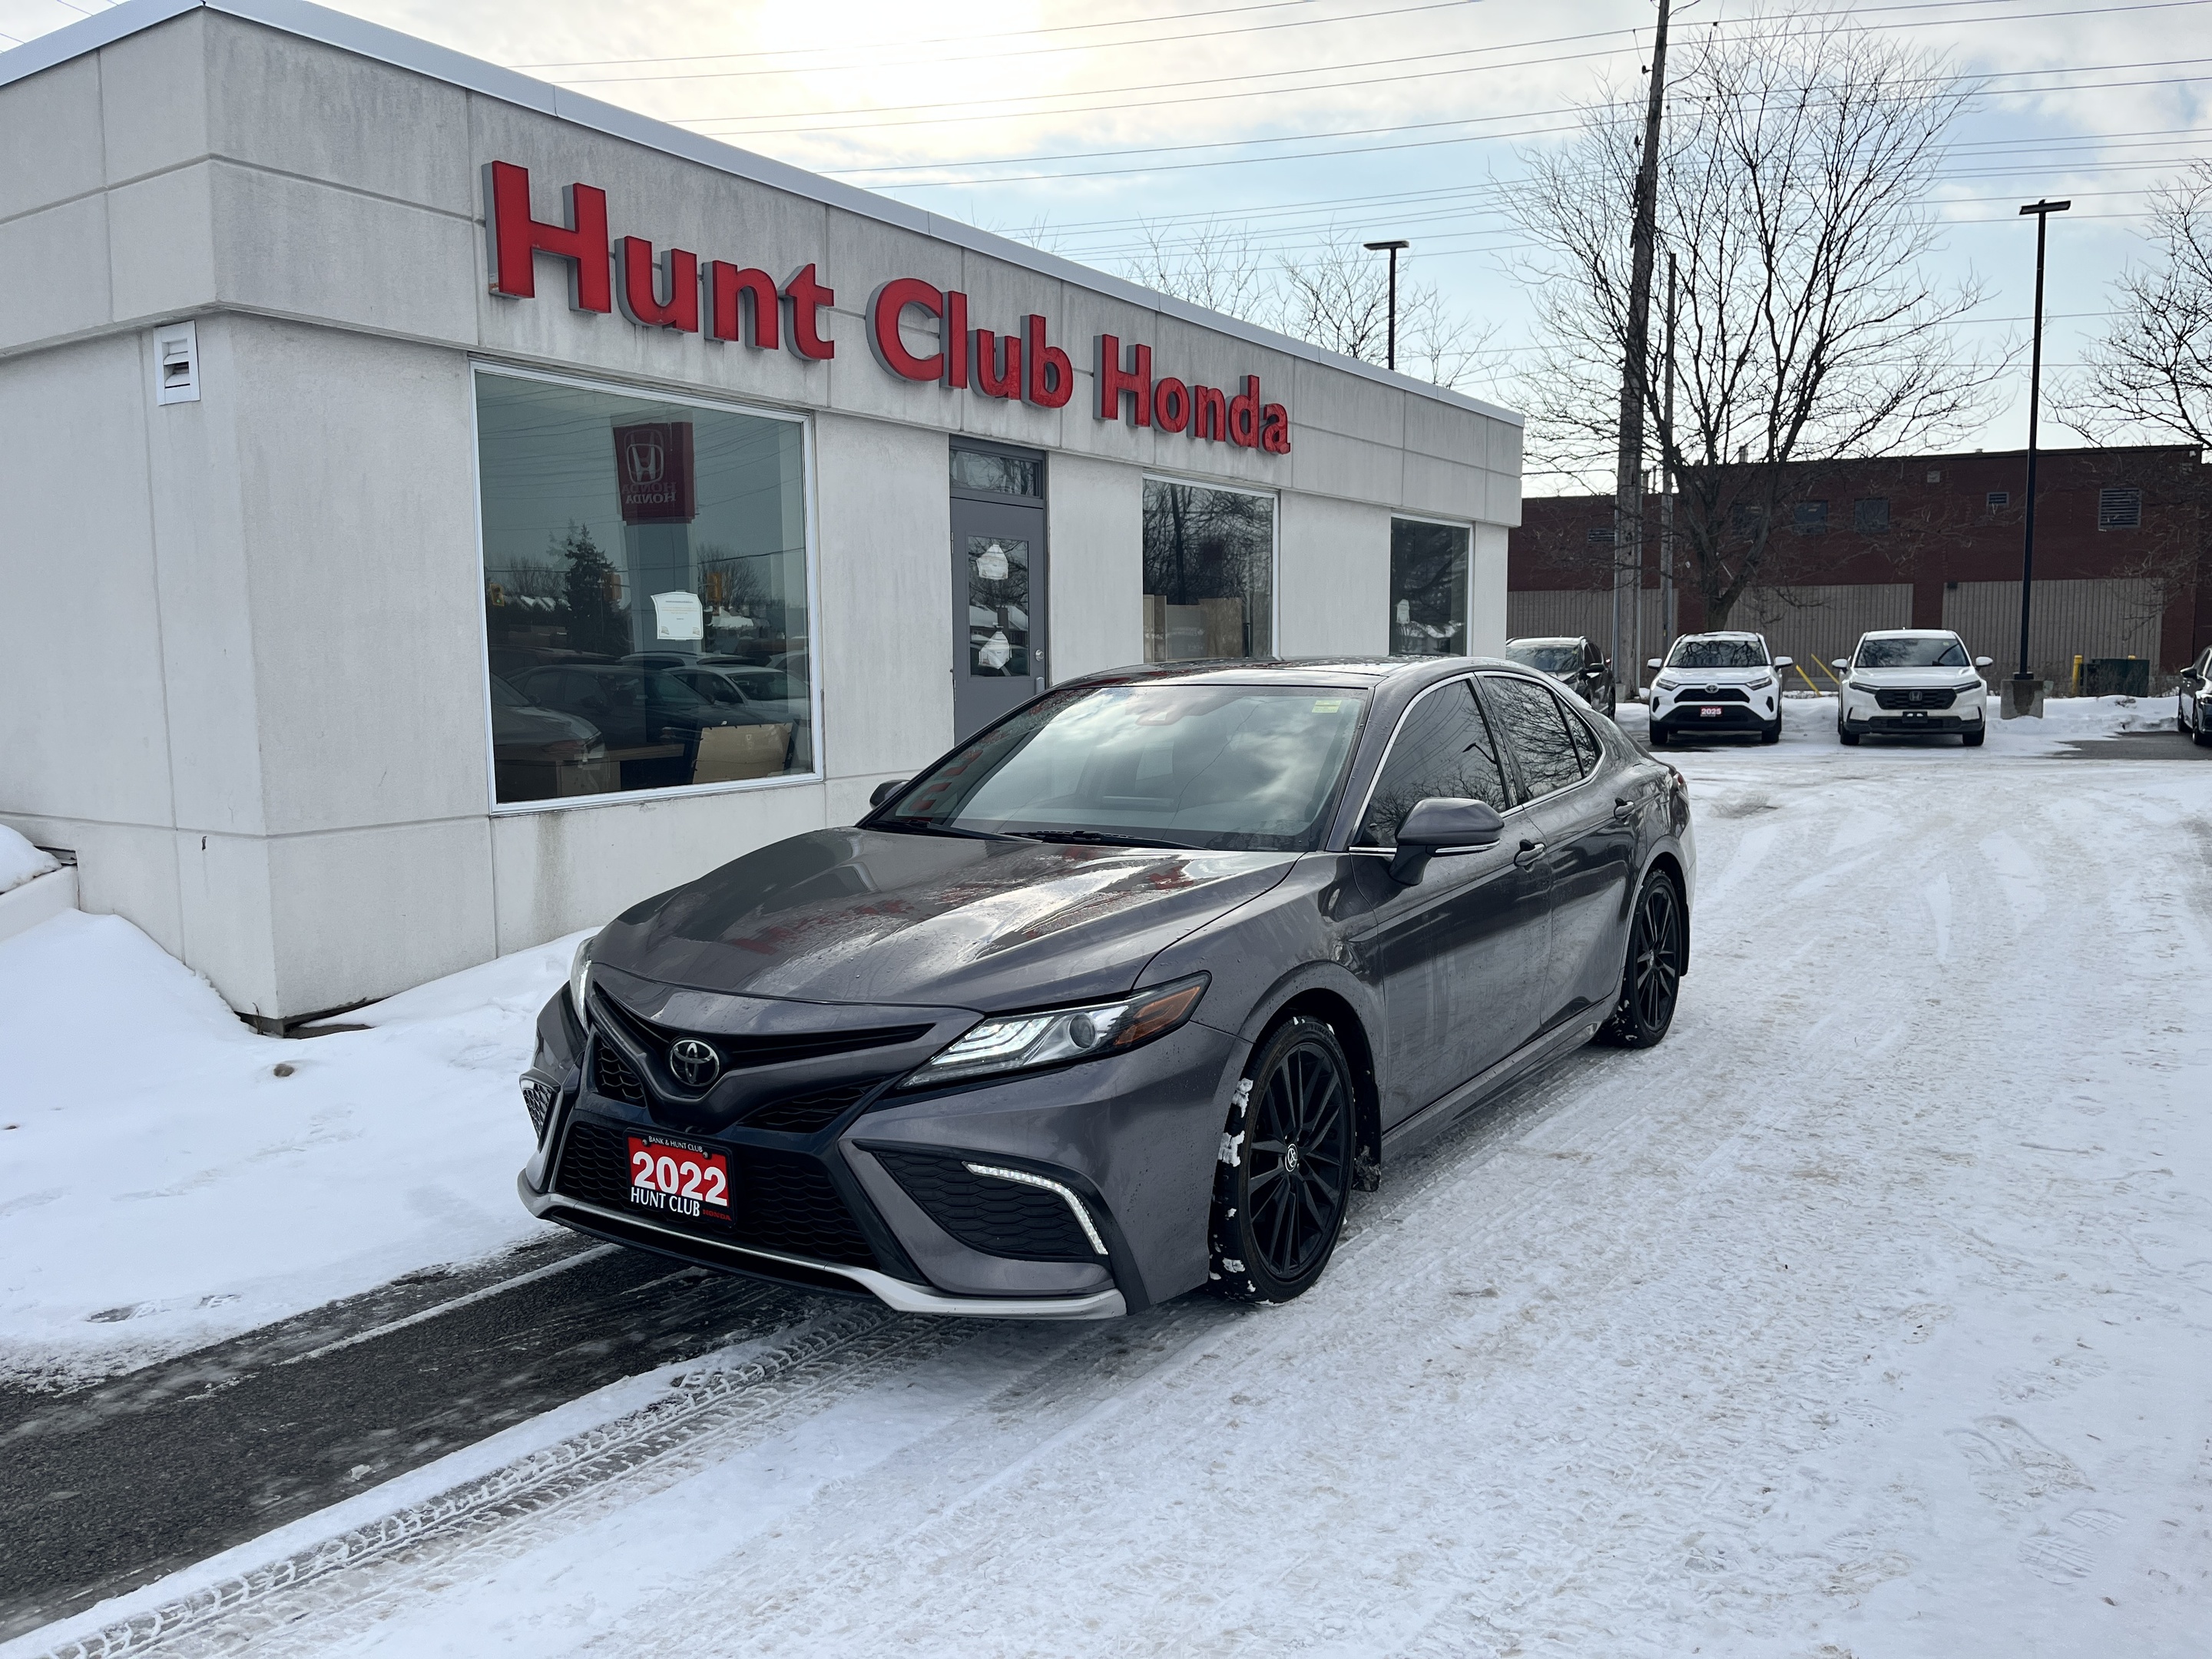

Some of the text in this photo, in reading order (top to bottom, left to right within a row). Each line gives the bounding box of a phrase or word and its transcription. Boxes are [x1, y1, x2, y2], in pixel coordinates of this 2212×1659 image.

[484, 161, 1290, 454] Hunt Club Honda
[648, 1136, 664, 1145] BANK
[671, 1141, 687, 1149] HUNT
[687, 1144, 703, 1152] CLUB
[633, 1151, 727, 1206] 2022
[631, 1187, 732, 1220] HUNT CLUB HONDA
